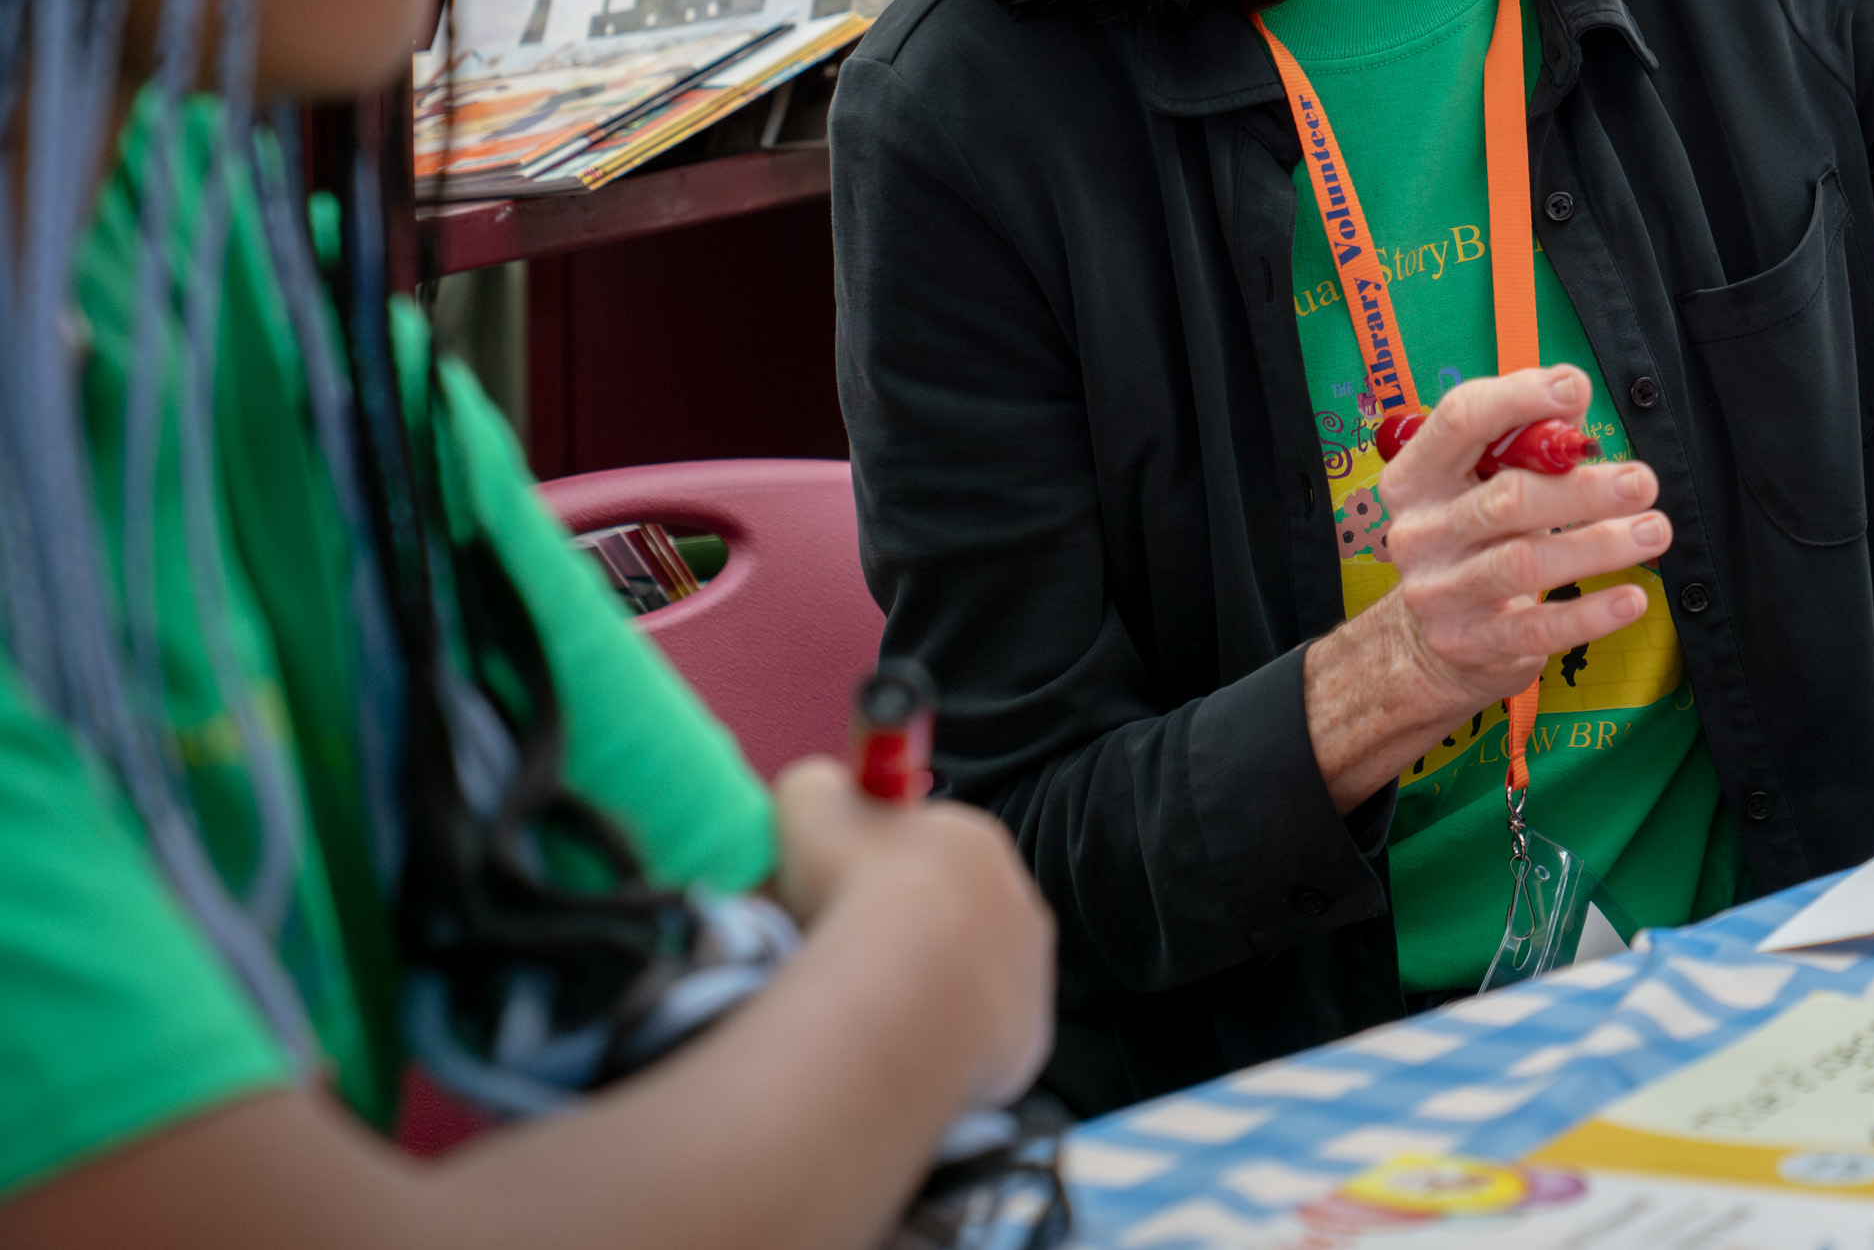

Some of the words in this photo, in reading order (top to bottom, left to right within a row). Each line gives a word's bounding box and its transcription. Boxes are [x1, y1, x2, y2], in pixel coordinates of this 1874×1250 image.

[1298, 94, 1362, 269] Volunteer
[1331, 379, 1355, 399] THE
[1354, 276, 1407, 413] Library
